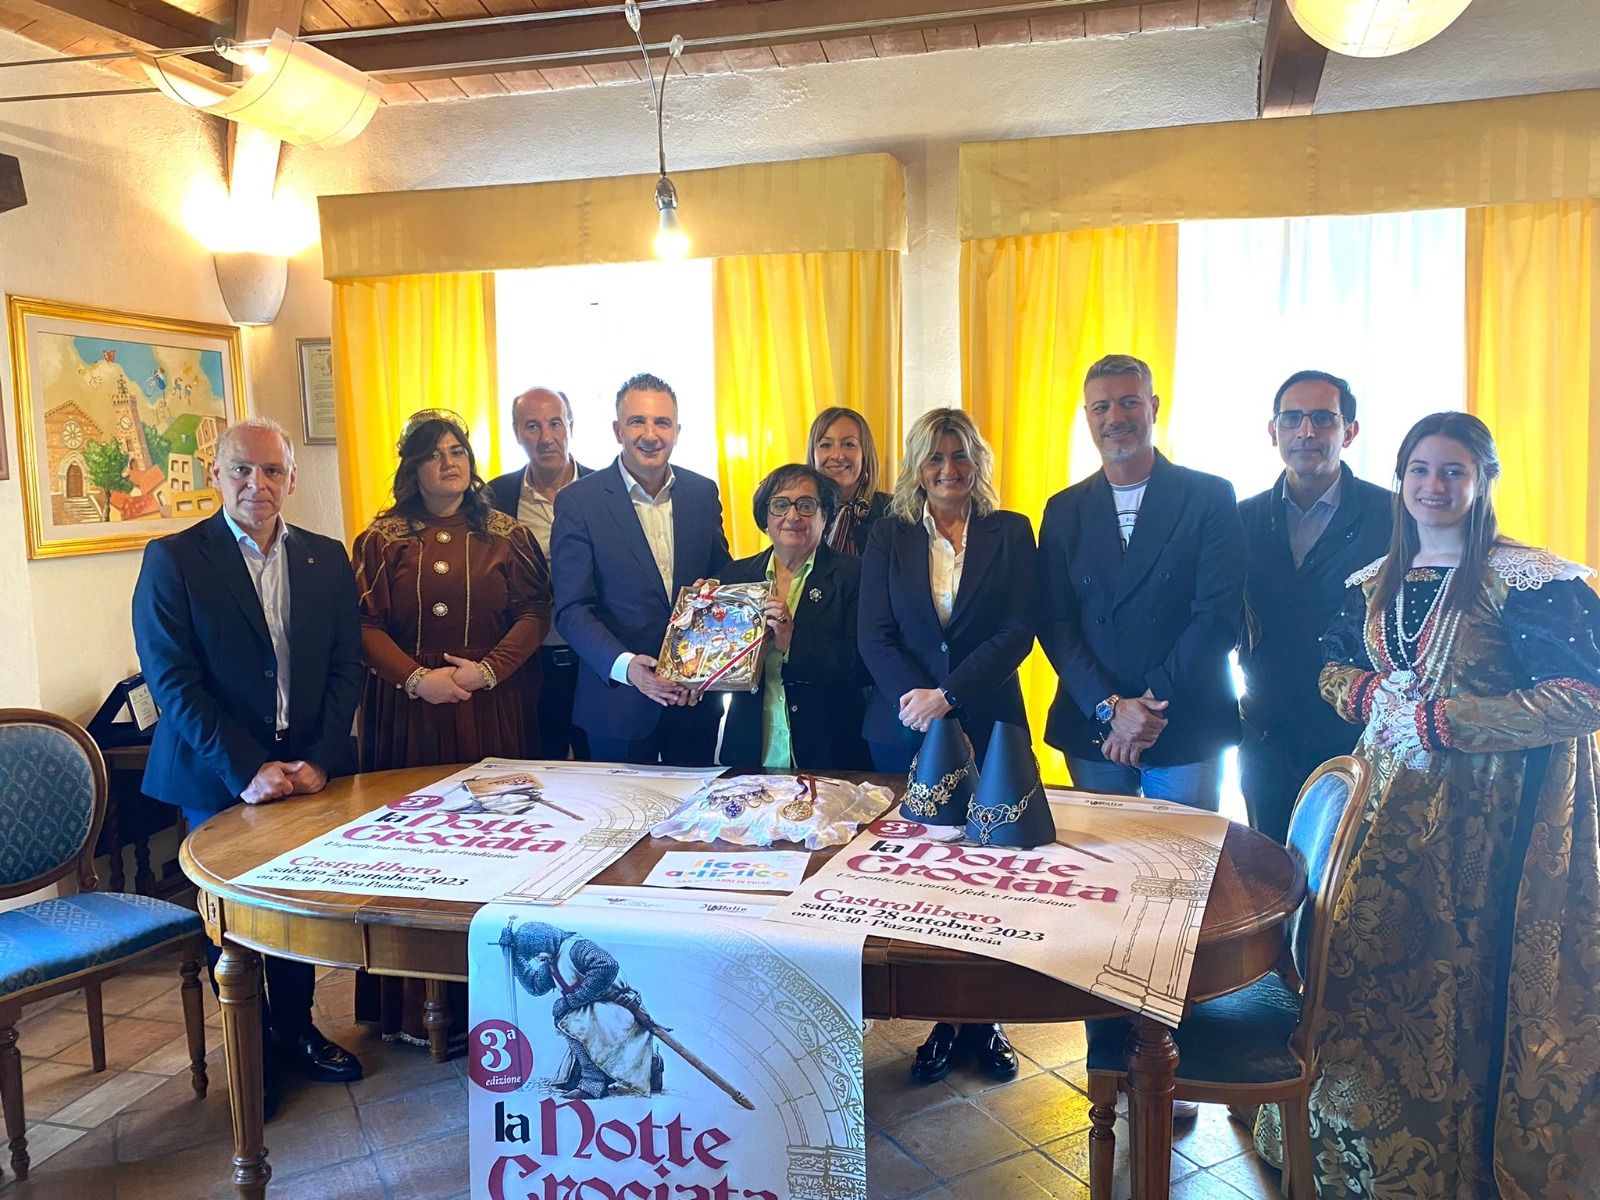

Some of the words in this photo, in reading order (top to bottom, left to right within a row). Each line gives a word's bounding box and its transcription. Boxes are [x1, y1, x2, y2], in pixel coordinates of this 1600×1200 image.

[343, 824, 566, 853] Crociata
[375, 811, 409, 823] la
[403, 812, 554, 835] Notte
[290, 856, 441, 875] Castrolibero
[869, 840, 905, 854] la
[905, 842, 1085, 878] Notte
[270, 867, 327, 876] sabato
[328, 869, 354, 877] 28
[353, 871, 420, 883] ottobre
[421, 875, 469, 886] 2023
[322, 878, 364, 887] Piazza
[366, 881, 426, 891] Pandosia
[847, 854, 1119, 903] Crociata
[854, 875, 894, 883] ponte
[895, 877, 915, 887] tra
[955, 888, 990, 898] fede
[1002, 894, 1077, 909] tradizione
[800, 902, 868, 917] sabato
[871, 909, 900, 921] 28
[902, 913, 984, 933] ottobre
[987, 926, 1046, 942] 2023
[814, 888, 1002, 925] Castrolibero
[791, 911, 817, 919] ore
[818, 913, 861, 925] 16.30
[871, 919, 923, 934] Piazza
[927, 927, 1002, 946] Pandosia
[485, 1074, 522, 1087] edizione
[494, 1100, 532, 1144] la
[539, 1097, 733, 1170] Notte
[487, 1154, 779, 1200] Croi
